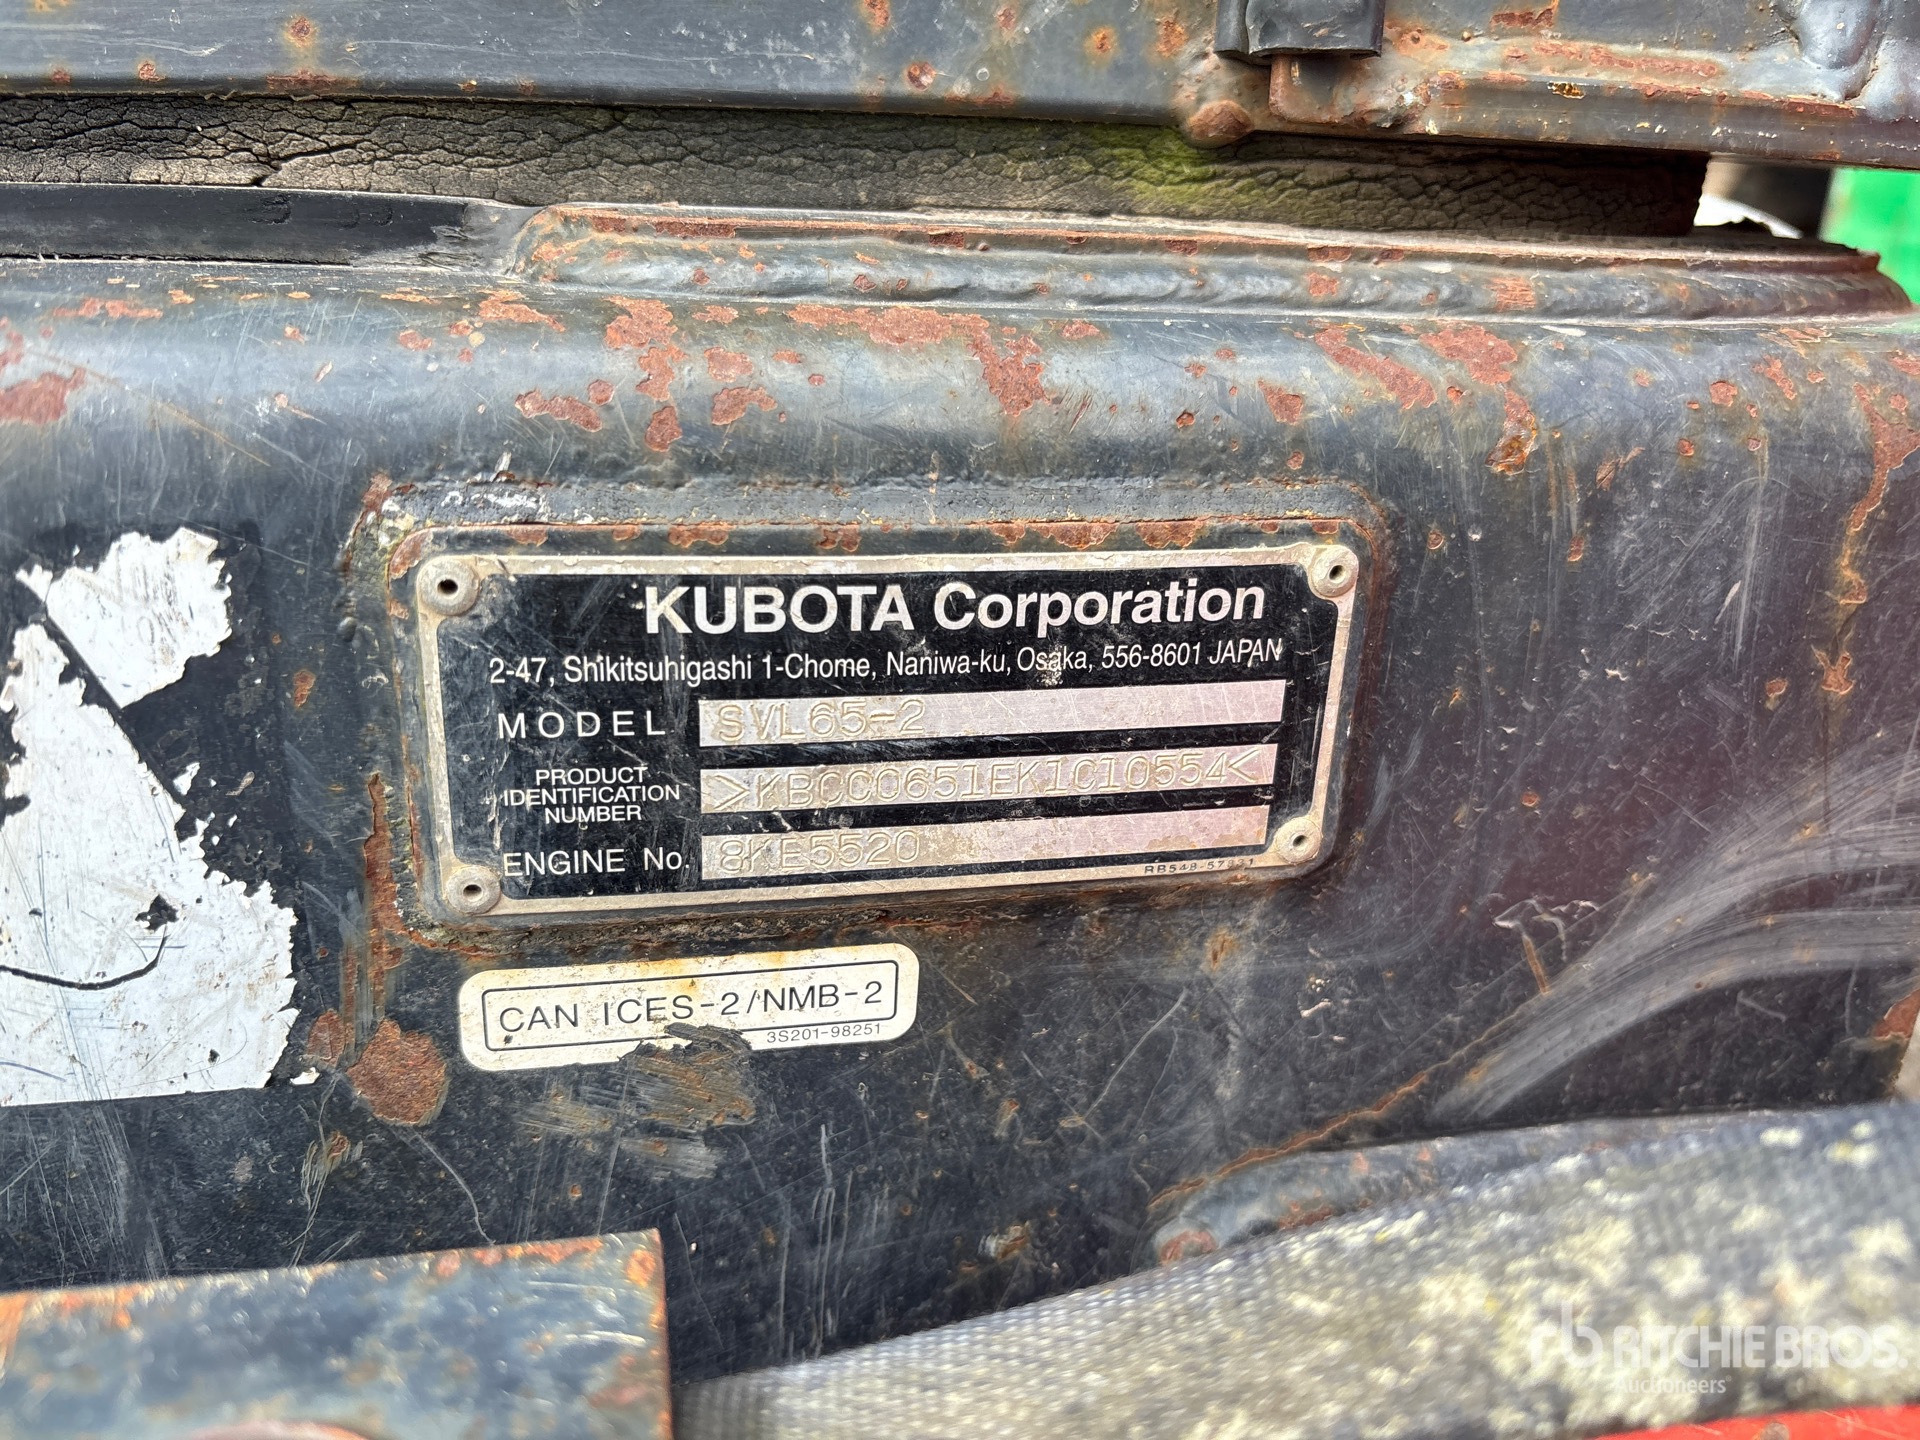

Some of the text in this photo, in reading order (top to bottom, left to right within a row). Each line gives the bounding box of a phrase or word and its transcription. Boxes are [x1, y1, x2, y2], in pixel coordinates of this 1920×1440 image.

[645, 579, 1265, 638] KUBOTA Corporation
[489, 638, 1283, 688] 2-47, Shikitsuhigashi 1-Chome, Naniwa-ku, Osaka, 556-8601 JAPAN
[497, 698, 926, 741] MODEL SVL65-2
[503, 785, 681, 808] IDENTIFICATION
[535, 766, 649, 786] PRODUCT
[544, 805, 643, 825] NUMBER
[502, 830, 921, 878] ENGINE No. 8KE5520
[499, 980, 883, 1033] CAN ICES-2/NMB-2
[766, 1022, 883, 1044] 3S201-98251
